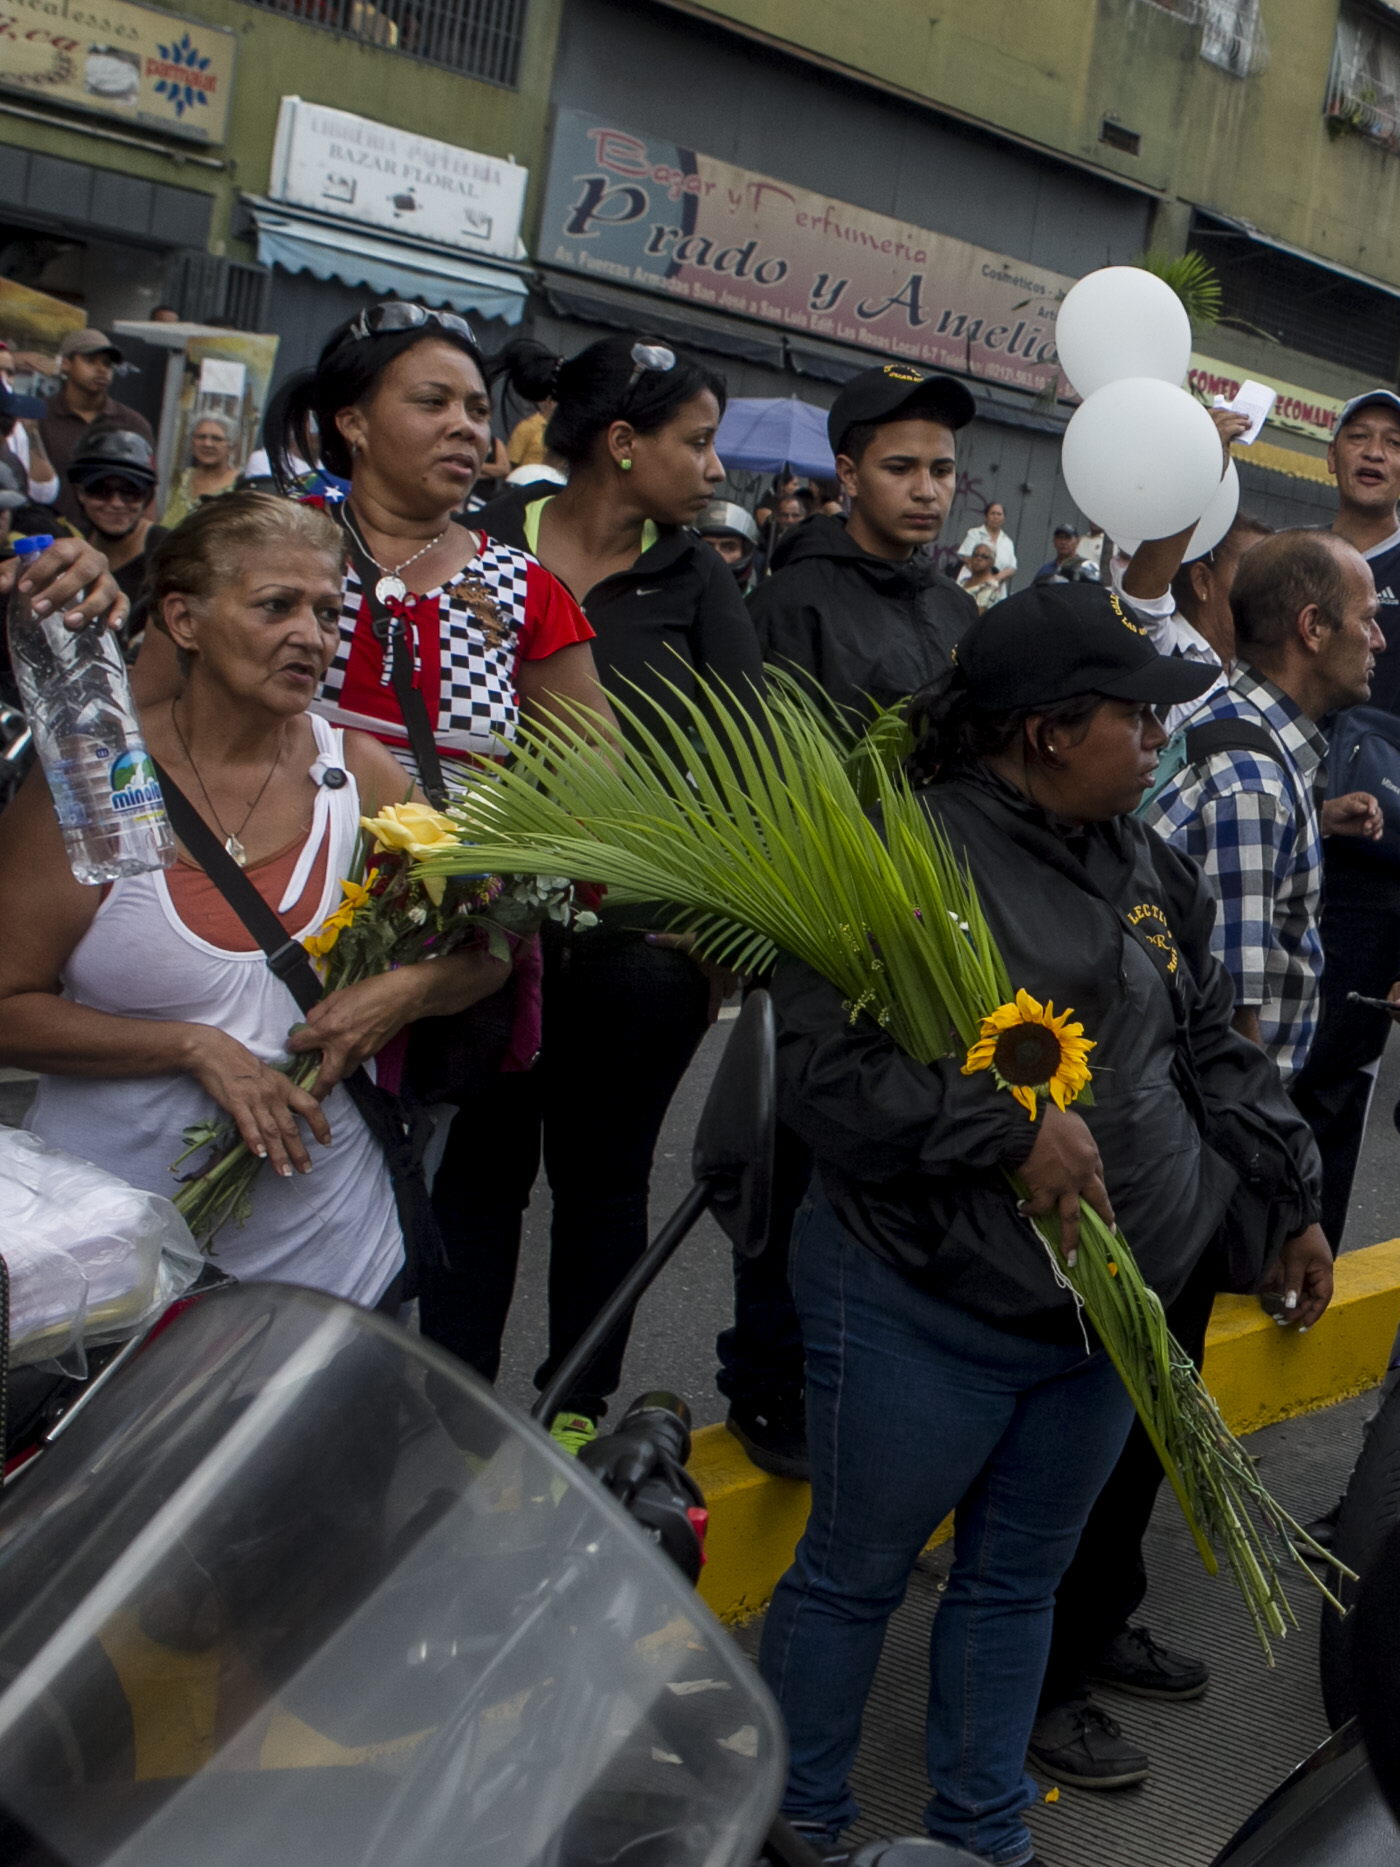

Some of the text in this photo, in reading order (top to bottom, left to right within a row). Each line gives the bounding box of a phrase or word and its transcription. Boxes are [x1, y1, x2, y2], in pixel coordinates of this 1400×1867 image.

[329, 143, 481, 199] BAZAR FLORAL
[728, 188, 742, 215] y
[563, 173, 788, 286] Prado
[809, 272, 848, 313] y
